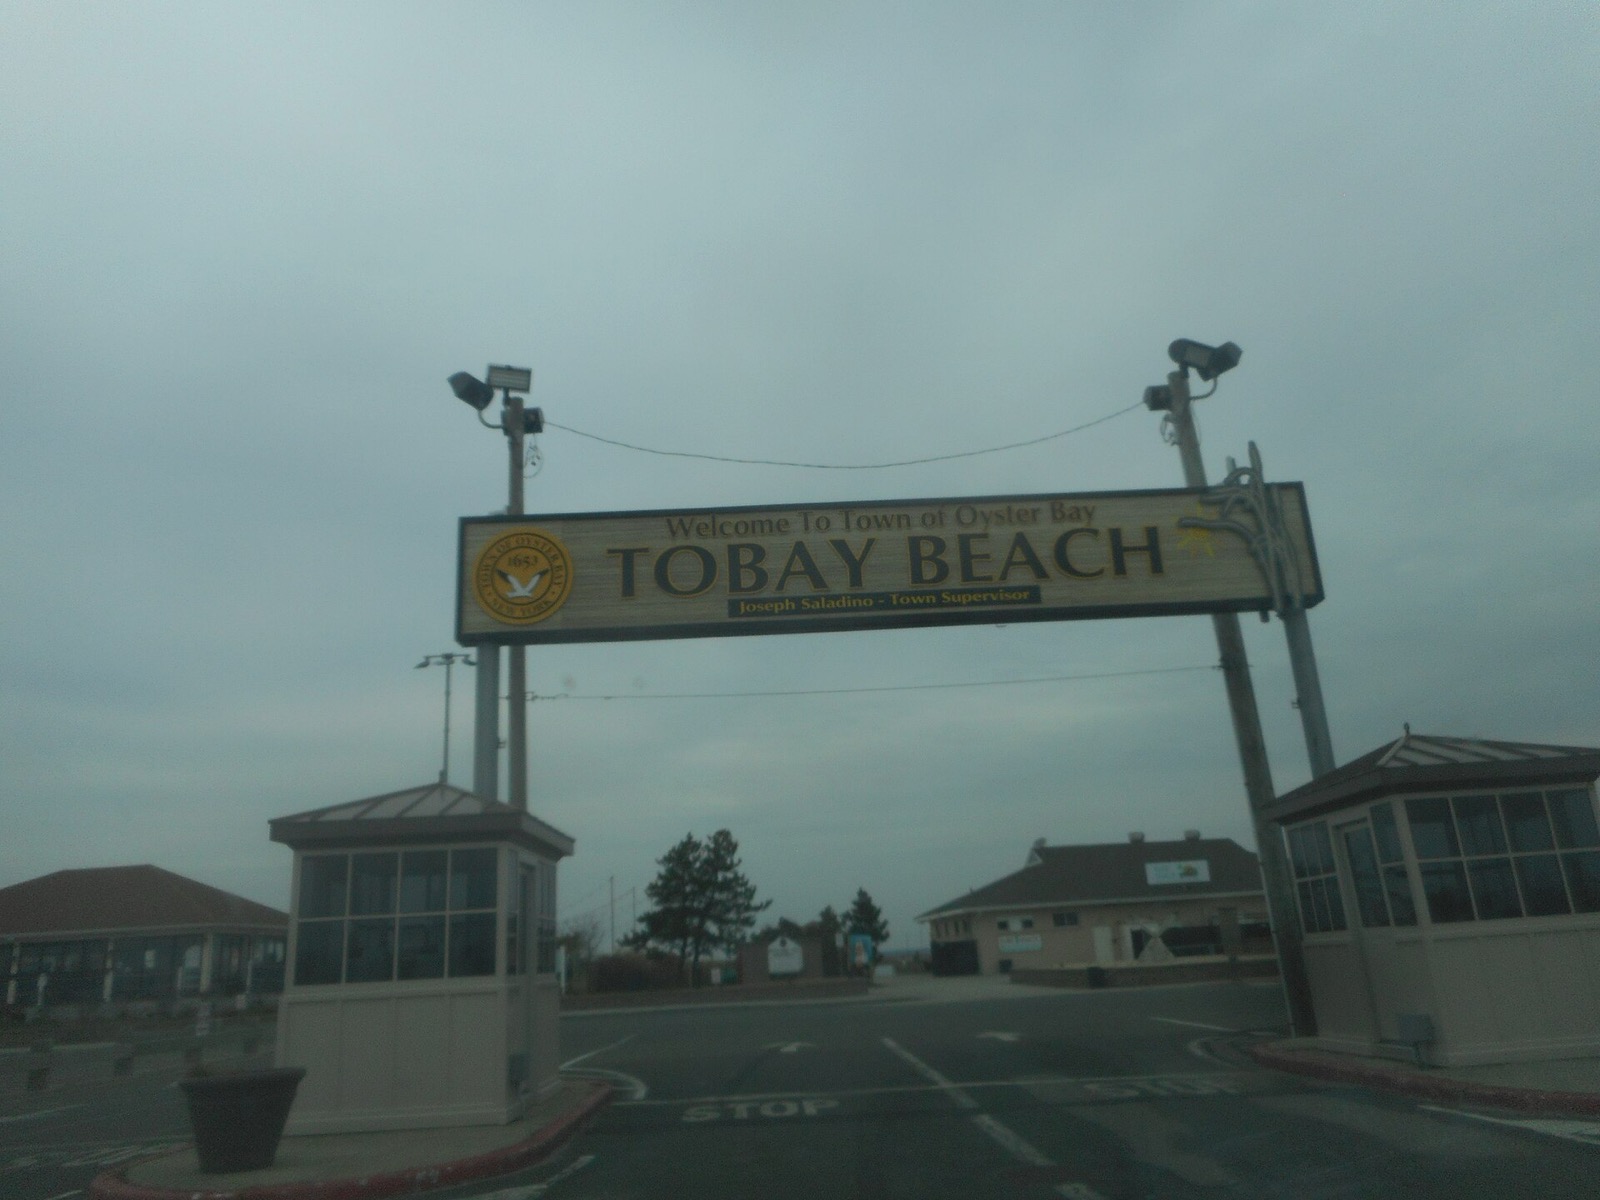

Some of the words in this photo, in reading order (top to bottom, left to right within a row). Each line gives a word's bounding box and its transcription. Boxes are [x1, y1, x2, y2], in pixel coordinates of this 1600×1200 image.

[666, 513, 790, 538] Welcome
[799, 511, 831, 532] To
[840, 509, 911, 531] Town
[921, 508, 946, 528] of
[955, 503, 1041, 530] Oyster
[1050, 500, 1096, 526] Bay
[607, 537, 879, 600] TOBAY
[904, 525, 1164, 586] BEACH
[739, 598, 796, 614] Joseph
[801, 595, 874, 610] Saladino
[889, 592, 936, 605] Town
[941, 588, 1031, 605] Supervisor
[682, 1099, 841, 1122] STOP
